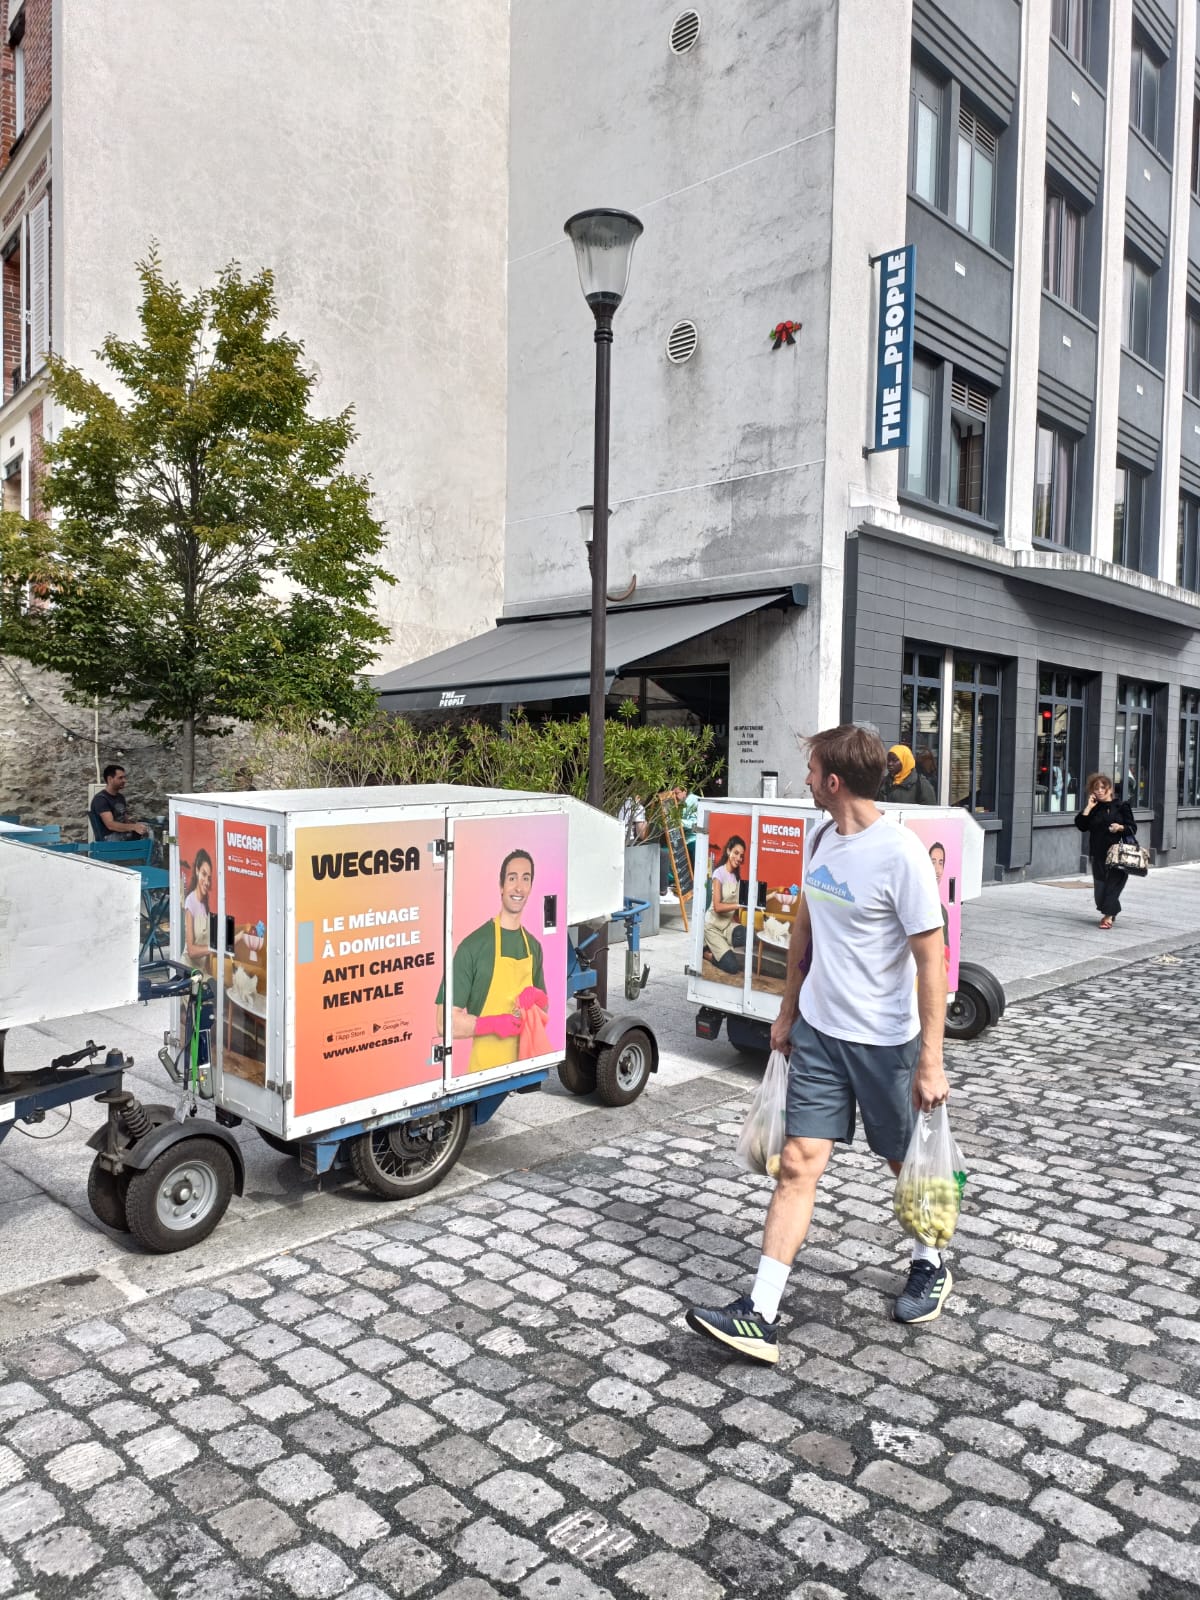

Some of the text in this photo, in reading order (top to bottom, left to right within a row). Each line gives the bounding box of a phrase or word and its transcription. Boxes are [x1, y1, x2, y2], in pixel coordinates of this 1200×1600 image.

[226, 831, 264, 853] WECASA
[762, 823, 801, 838] WECASA
[311, 846, 420, 880] WECASA
[322, 906, 420, 933] LE MÉNAGE
[322, 930, 421, 959] À DOMICILE
[322, 952, 435, 984] ANTI CHARGE
[323, 981, 404, 1010] MENTALE
[323, 1031, 413, 1060] www.wecasa.fr
